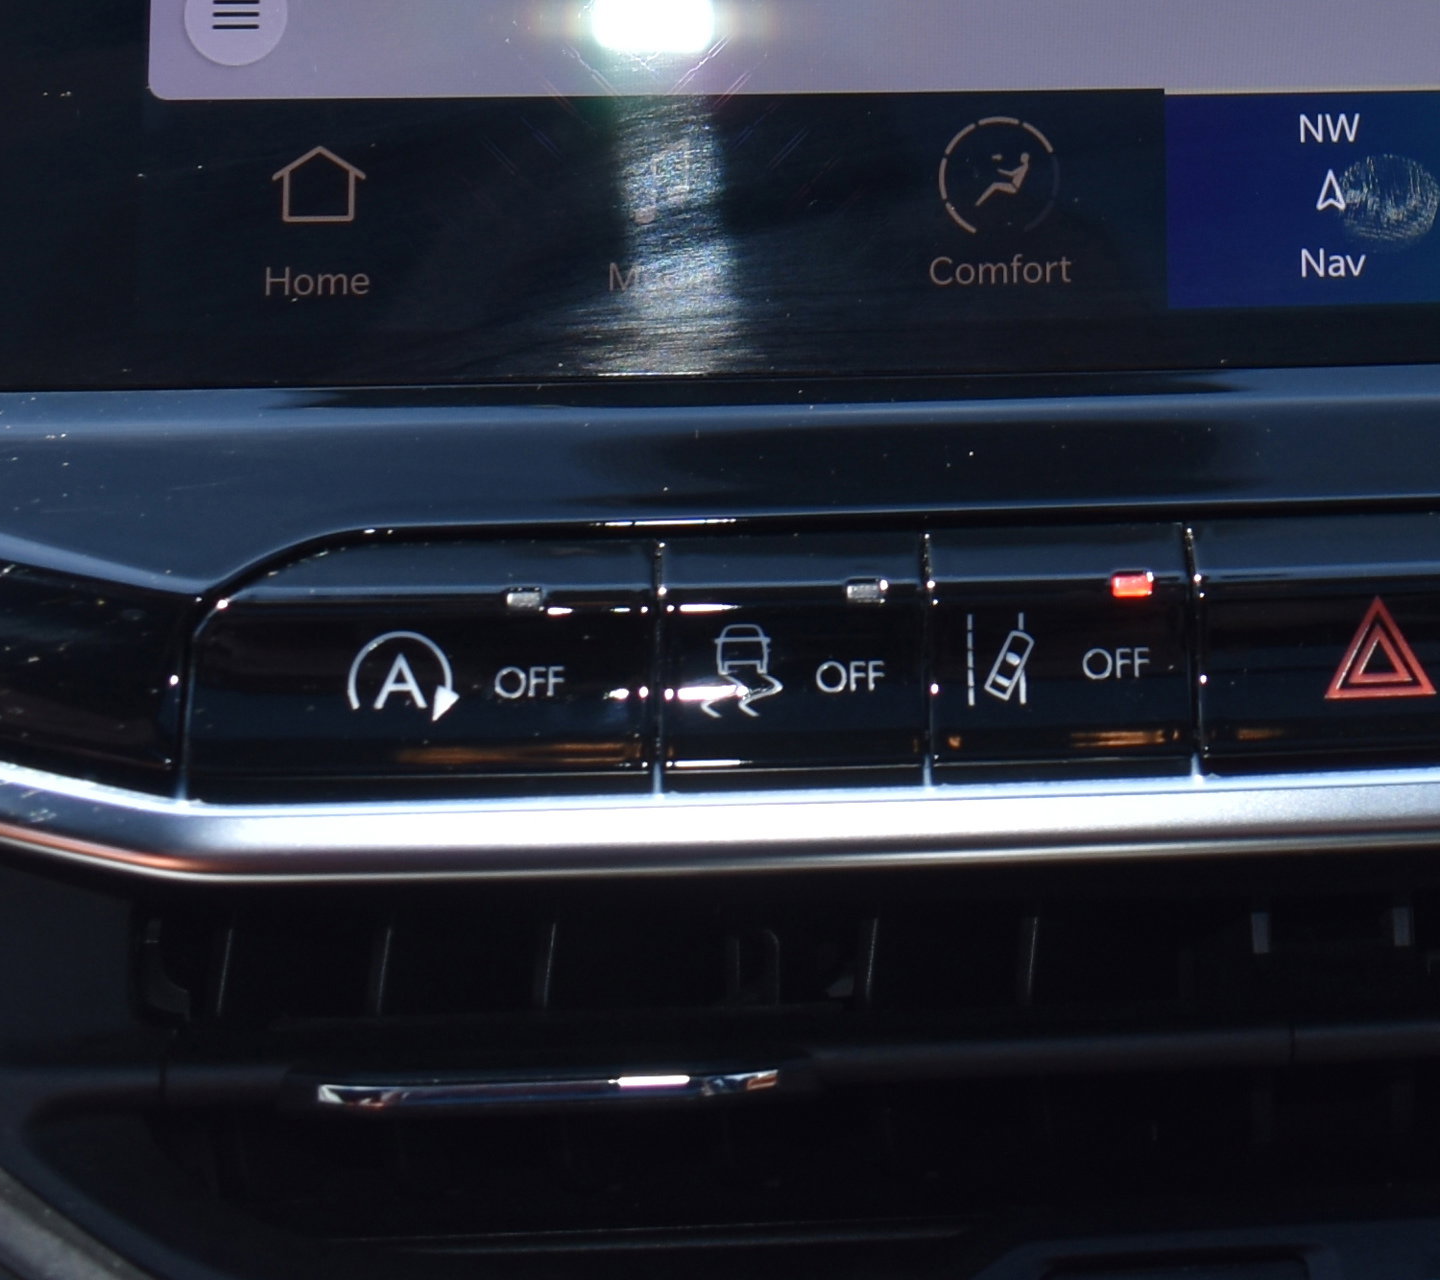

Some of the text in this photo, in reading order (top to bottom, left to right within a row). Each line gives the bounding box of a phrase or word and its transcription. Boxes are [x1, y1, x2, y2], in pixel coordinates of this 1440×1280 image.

[1299, 112, 1360, 143] NW
[265, 266, 370, 296] Home
[929, 253, 1072, 286] Comfort
[1301, 247, 1366, 278] Nav
[815, 660, 884, 693] OFF
[1082, 647, 1149, 680] OFF
[495, 666, 565, 699] OFF
